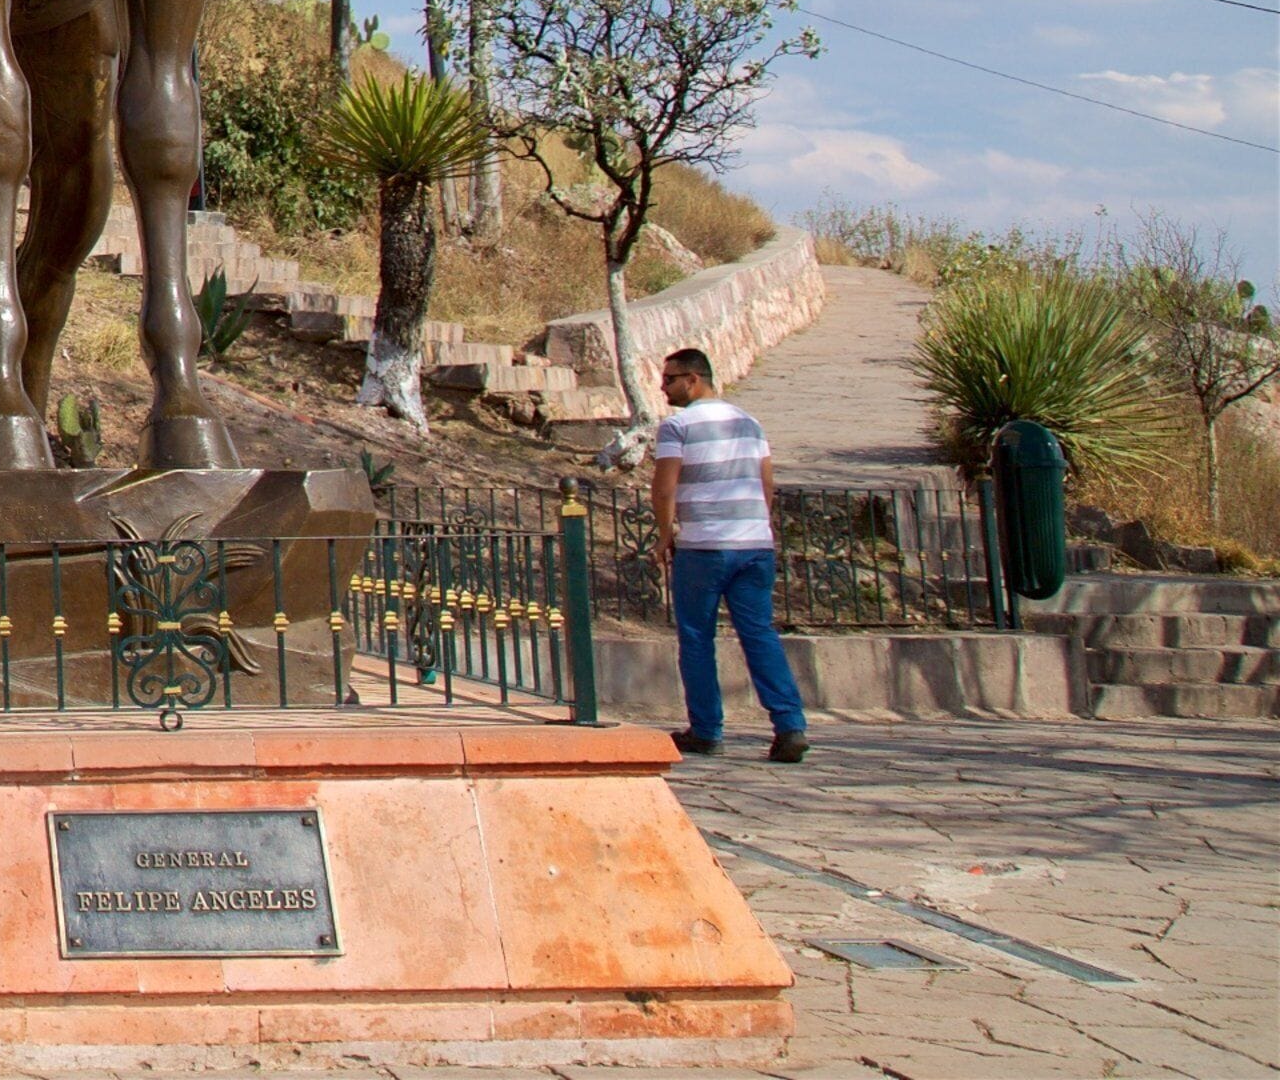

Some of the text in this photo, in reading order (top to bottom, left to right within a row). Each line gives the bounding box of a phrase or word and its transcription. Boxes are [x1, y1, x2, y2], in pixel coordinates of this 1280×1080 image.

[136, 851, 249, 868] GENERAL
[77, 888, 318, 912] FELIPE ANGELES
